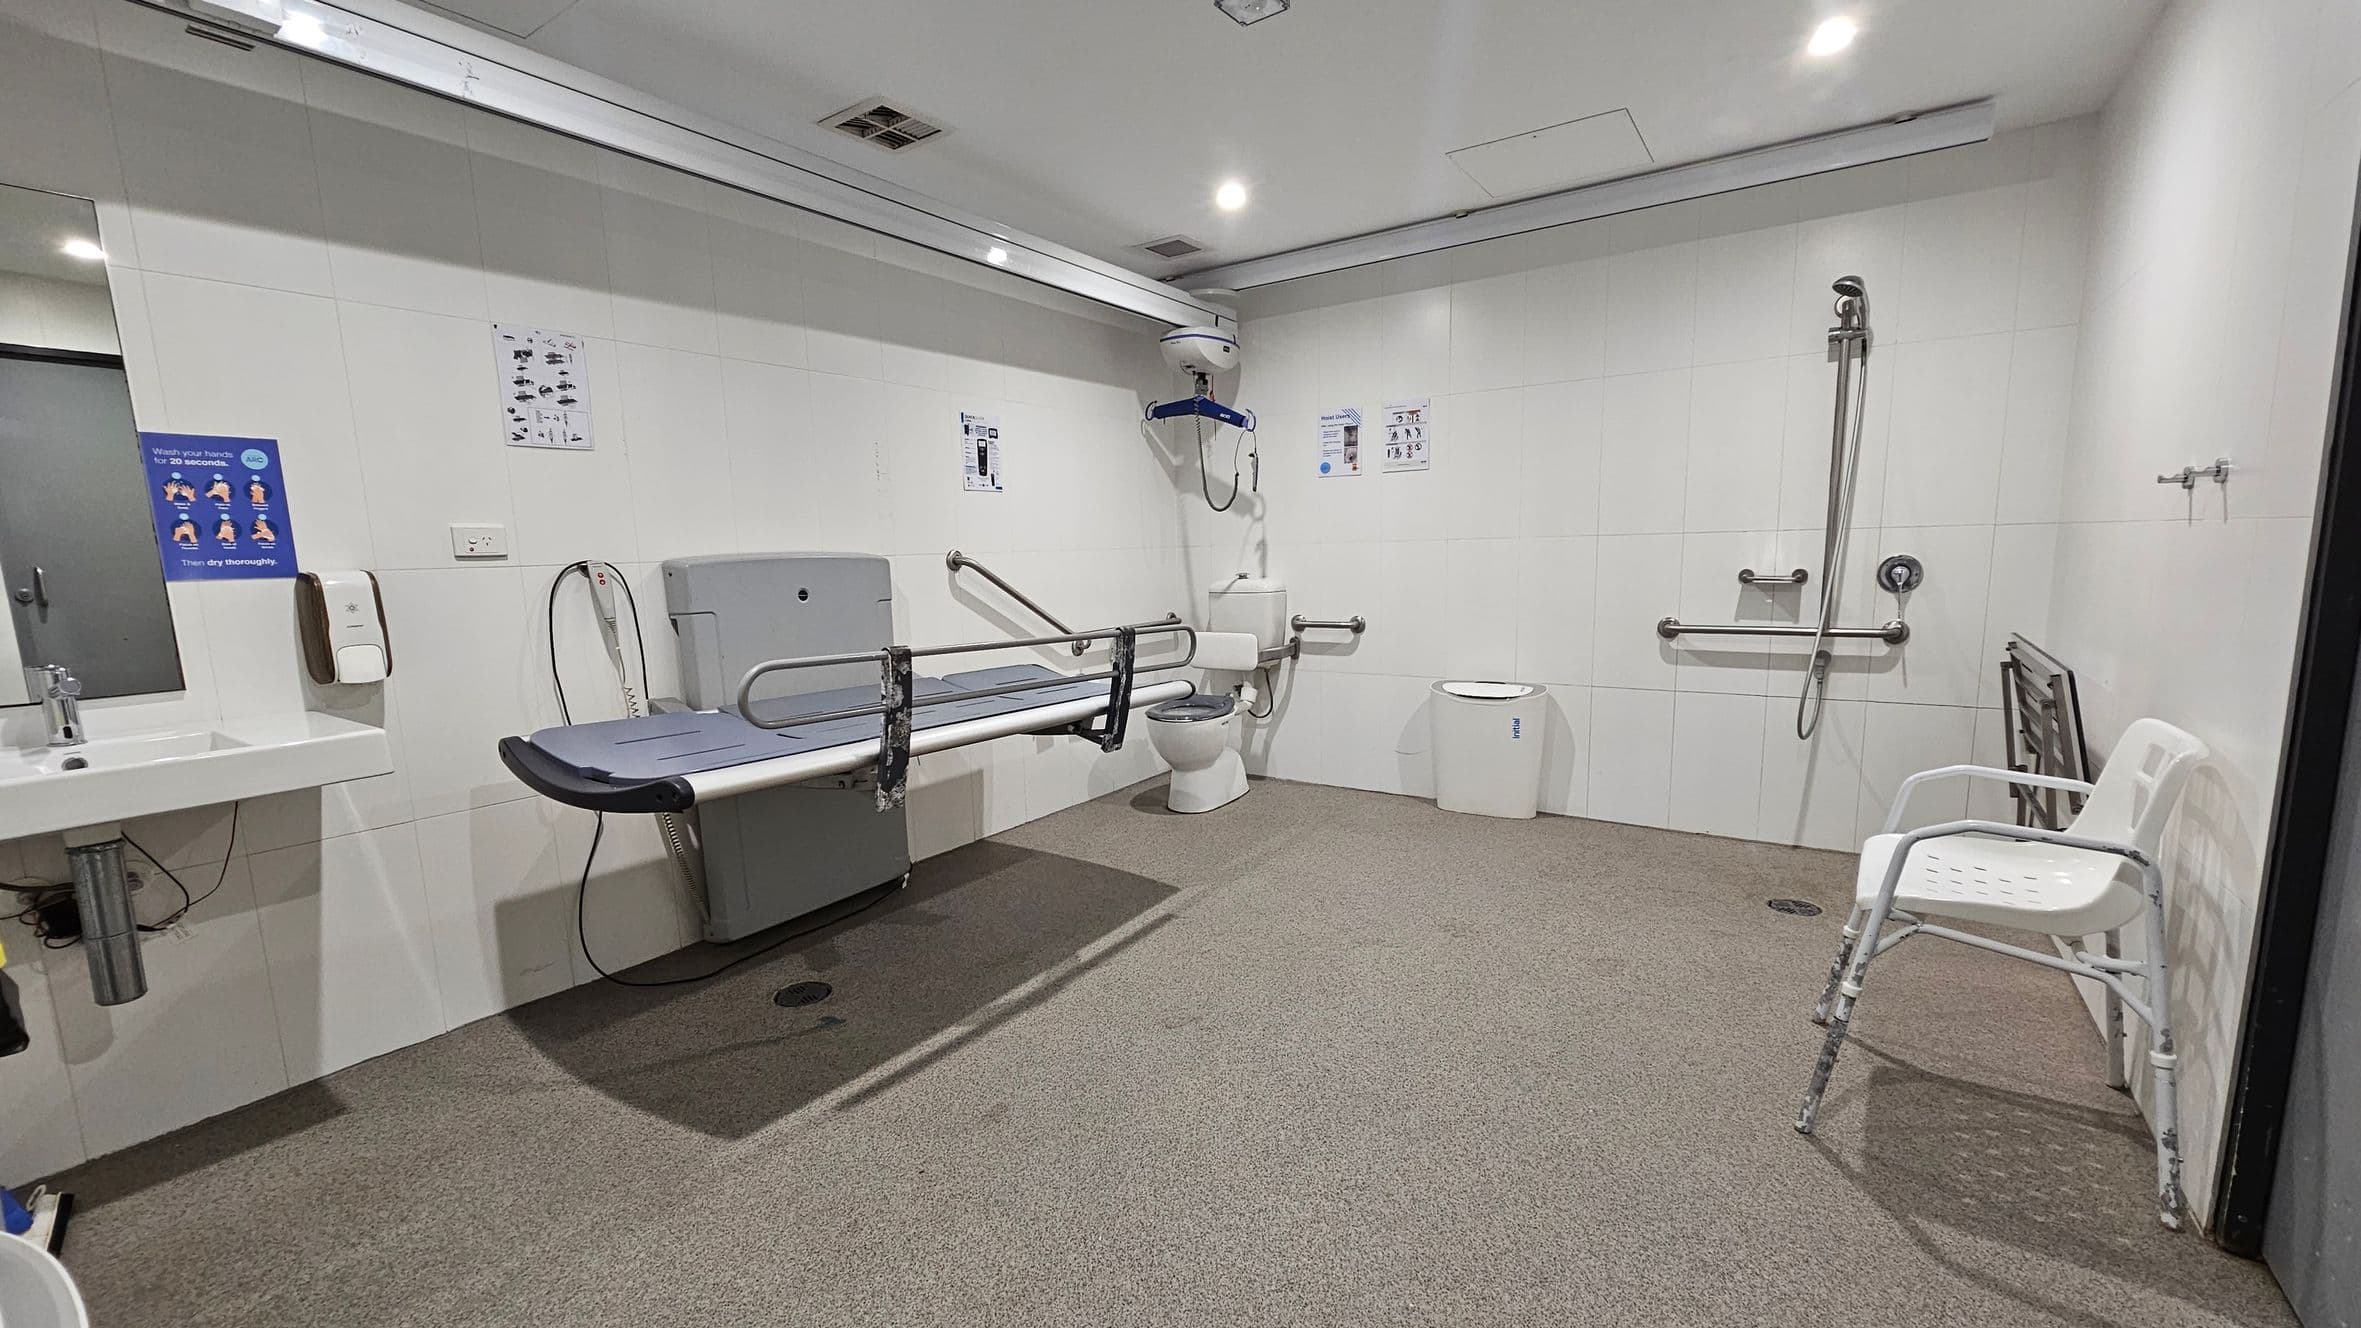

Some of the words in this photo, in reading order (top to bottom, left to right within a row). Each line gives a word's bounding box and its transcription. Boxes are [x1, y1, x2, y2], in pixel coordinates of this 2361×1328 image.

[152, 447, 181, 456] Wash
[182, 450, 203, 458] your
[204, 450, 234, 458] hands
[169, 457, 182, 465] 20
[184, 459, 229, 467] seconds.
[181, 559, 205, 567] Then
[207, 559, 223, 567] dry
[224, 557, 278, 567] thoroughly.
